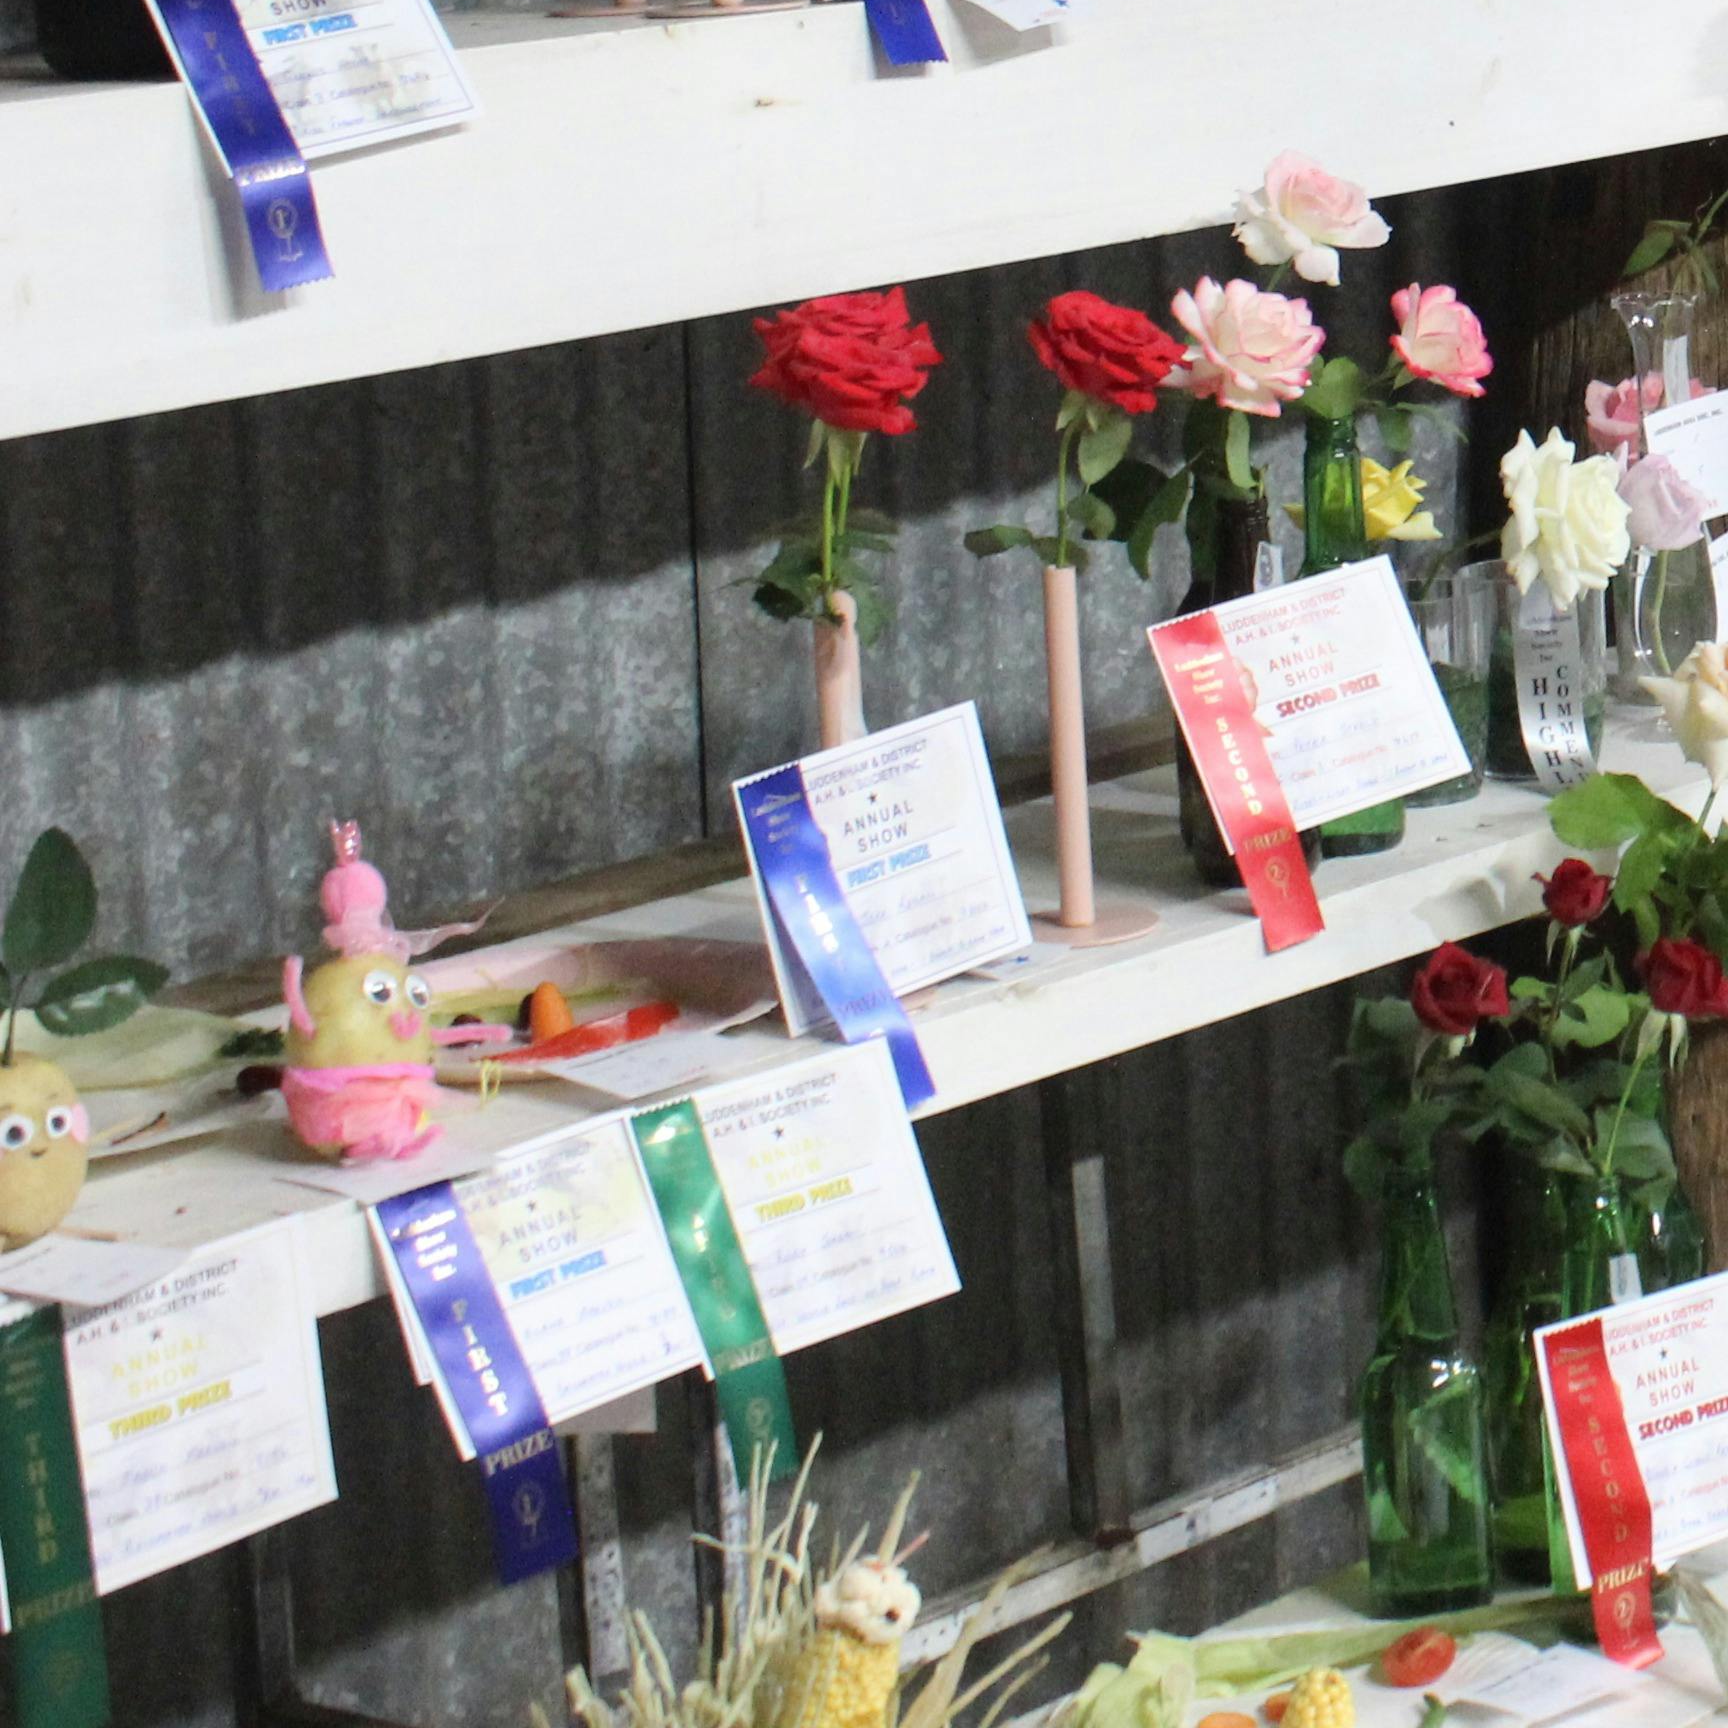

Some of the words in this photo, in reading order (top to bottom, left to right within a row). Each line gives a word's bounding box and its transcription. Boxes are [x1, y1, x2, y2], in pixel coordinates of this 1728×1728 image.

[262, 23, 307, 46] FIRST
[308, 13, 358, 36] PRIZE
[1297, 588, 1346, 615] DISTRICT
[1268, 641, 1340, 673] ANNUAL
[1284, 660, 1336, 688] SHOW
[1275, 686, 1337, 719] SECOND
[1339, 673, 1382, 699] PRIZE
[808, 762, 871, 791] UDDENHAM
[881, 738, 928, 765] DISTRICT
[1214, 716, 1264, 818] SECOND
[843, 801, 914, 836] ANNUAL
[857, 823, 909, 853] SHOW
[1243, 827, 1293, 856] PRIZE
[847, 859, 886, 888] FIRST
[888, 843, 931, 874] PRIZE
[785, 1073, 837, 1100] DISTRICT
[759, 1102, 811, 1126] SOCIETY
[748, 1136, 832, 1170] ANNUAL
[765, 1157, 823, 1188] SHOW
[754, 1192, 806, 1224] THIRD
[807, 1176, 855, 1206] PRIZE
[500, 1208, 582, 1251] ANNUAL
[519, 1228, 580, 1264] SHOW
[174, 1258, 238, 1292] DISTRICT
[510, 1267, 557, 1300] FIRST
[559, 1250, 607, 1280] PRIZE
[137, 1294, 197, 1326] SOCIETY
[1606, 1312, 1661, 1342] UDDENHAM
[1672, 1298, 1716, 1323] DISTRICT
[1648, 1325, 1691, 1351] SOCIETY
[111, 1335, 208, 1381] ANNUAL
[450, 1297, 509, 1418] FIRST
[1636, 1357, 1700, 1391] ANNUAL
[128, 1361, 199, 1401] SHOW
[1649, 1380, 1695, 1409] SHOW
[108, 1405, 172, 1441] THIRD
[176, 1378, 232, 1418] PRIZE
[1638, 1407, 1694, 1441] SECOND
[484, 1429, 555, 1478] PRIZE
[1588, 1415, 1630, 1545] SECOND
[23, 1431, 59, 1565] THIRD
[1598, 1558, 1650, 1595] PRIZE
